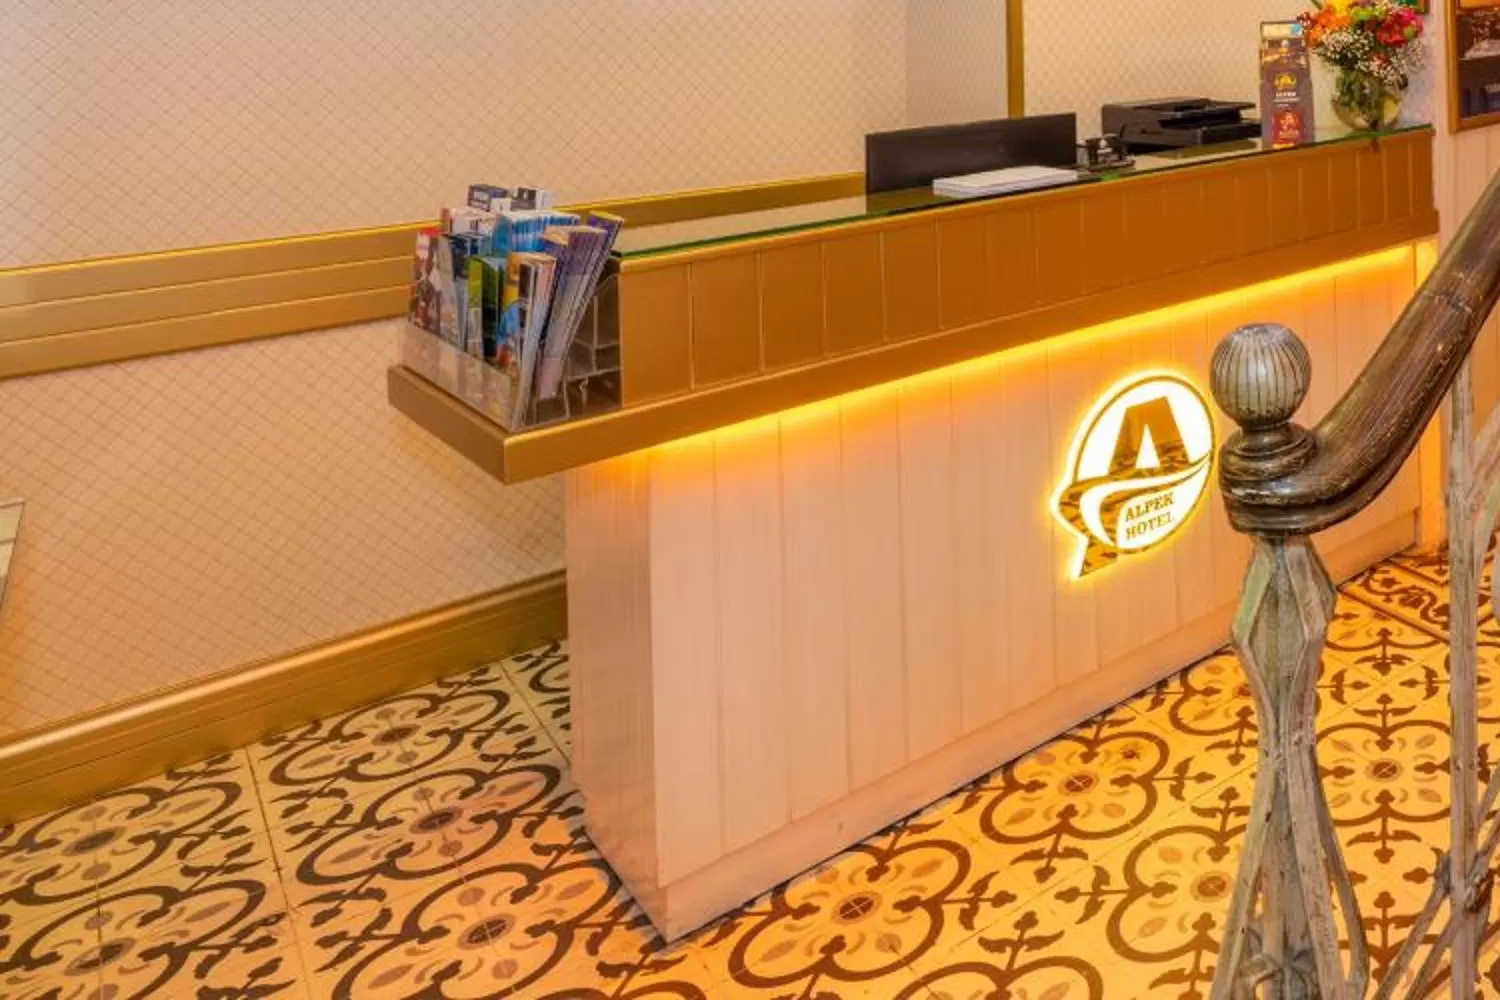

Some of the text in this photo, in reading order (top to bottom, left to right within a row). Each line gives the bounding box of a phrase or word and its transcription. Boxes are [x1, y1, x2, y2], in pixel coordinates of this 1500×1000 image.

[1107, 395, 1190, 476] A
[1125, 491, 1174, 522] ALPEK
[1126, 510, 1173, 541] HOTEL
